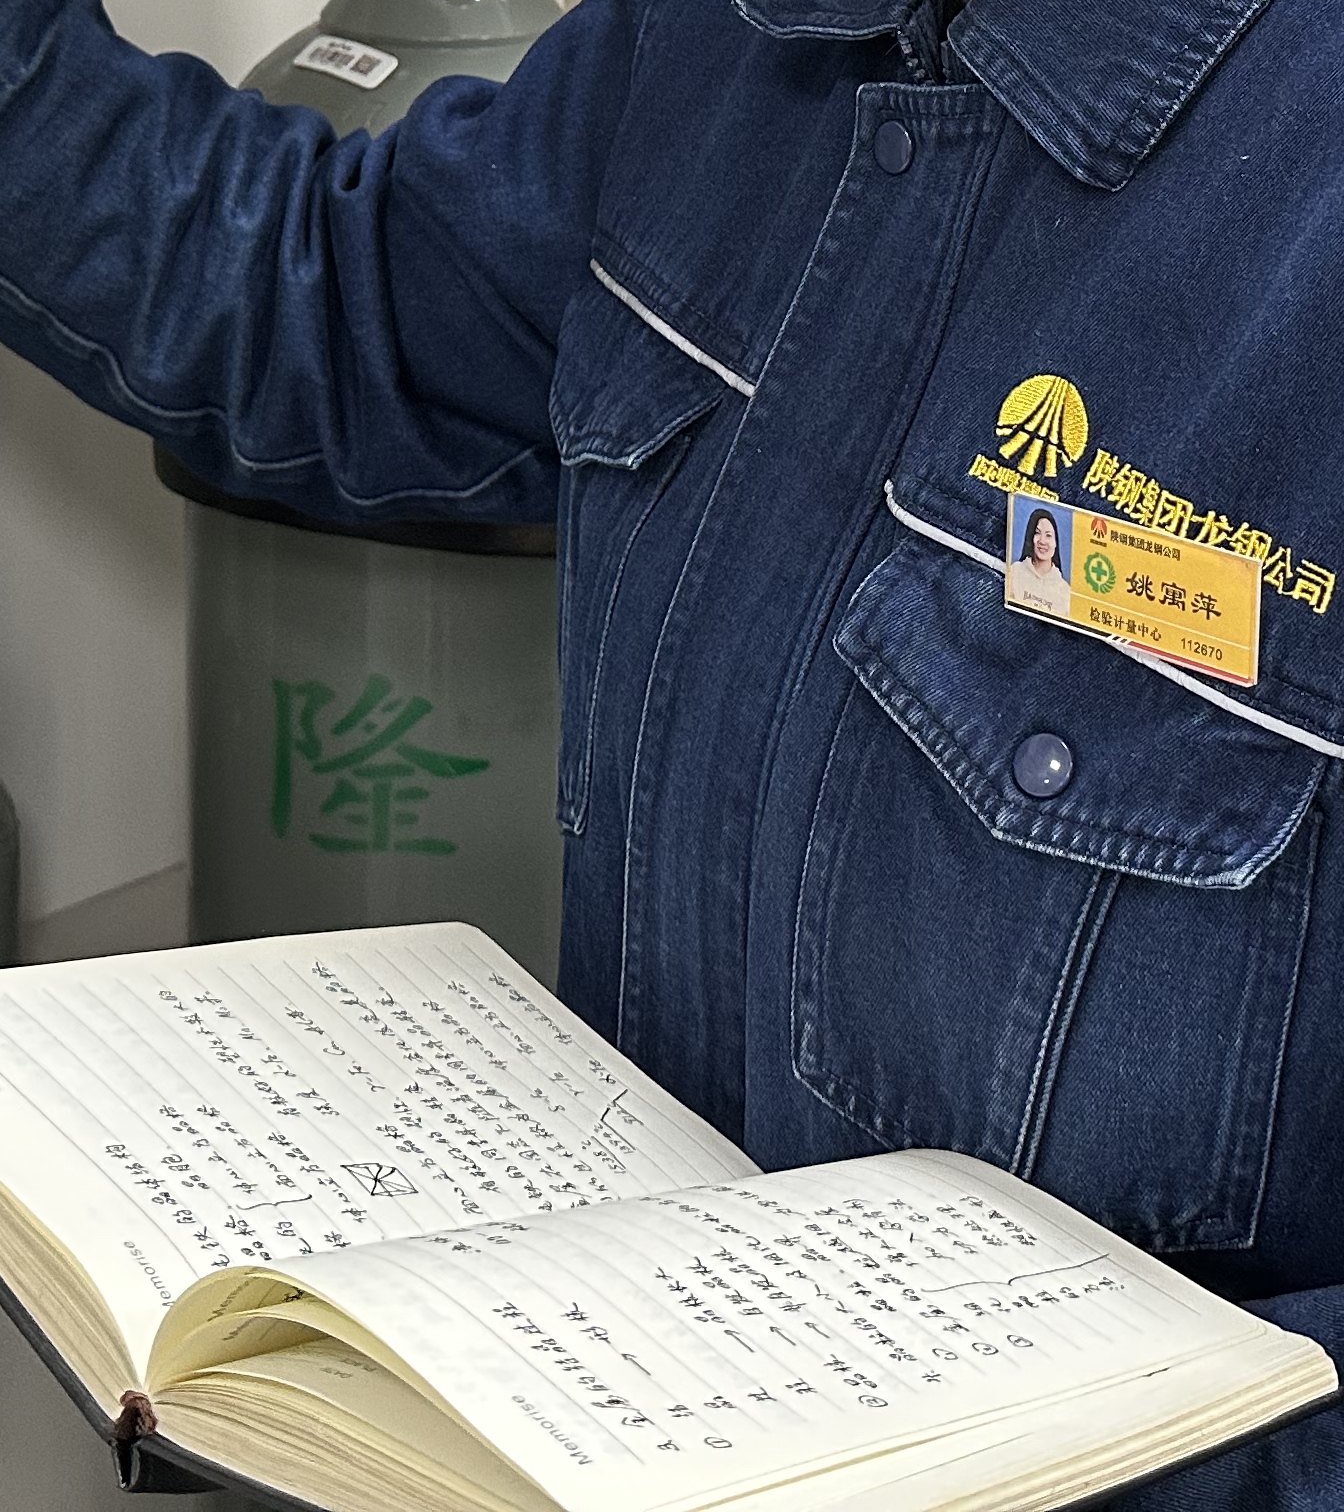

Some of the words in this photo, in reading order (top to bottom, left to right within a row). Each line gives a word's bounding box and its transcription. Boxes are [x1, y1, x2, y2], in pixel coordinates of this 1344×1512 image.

[1089, 606, 1162, 642] 检验计量中心
[1180, 636, 1224, 662] 112670
[272, 673, 493, 856] 隆
[511, 1395, 594, 1466] Memorise
